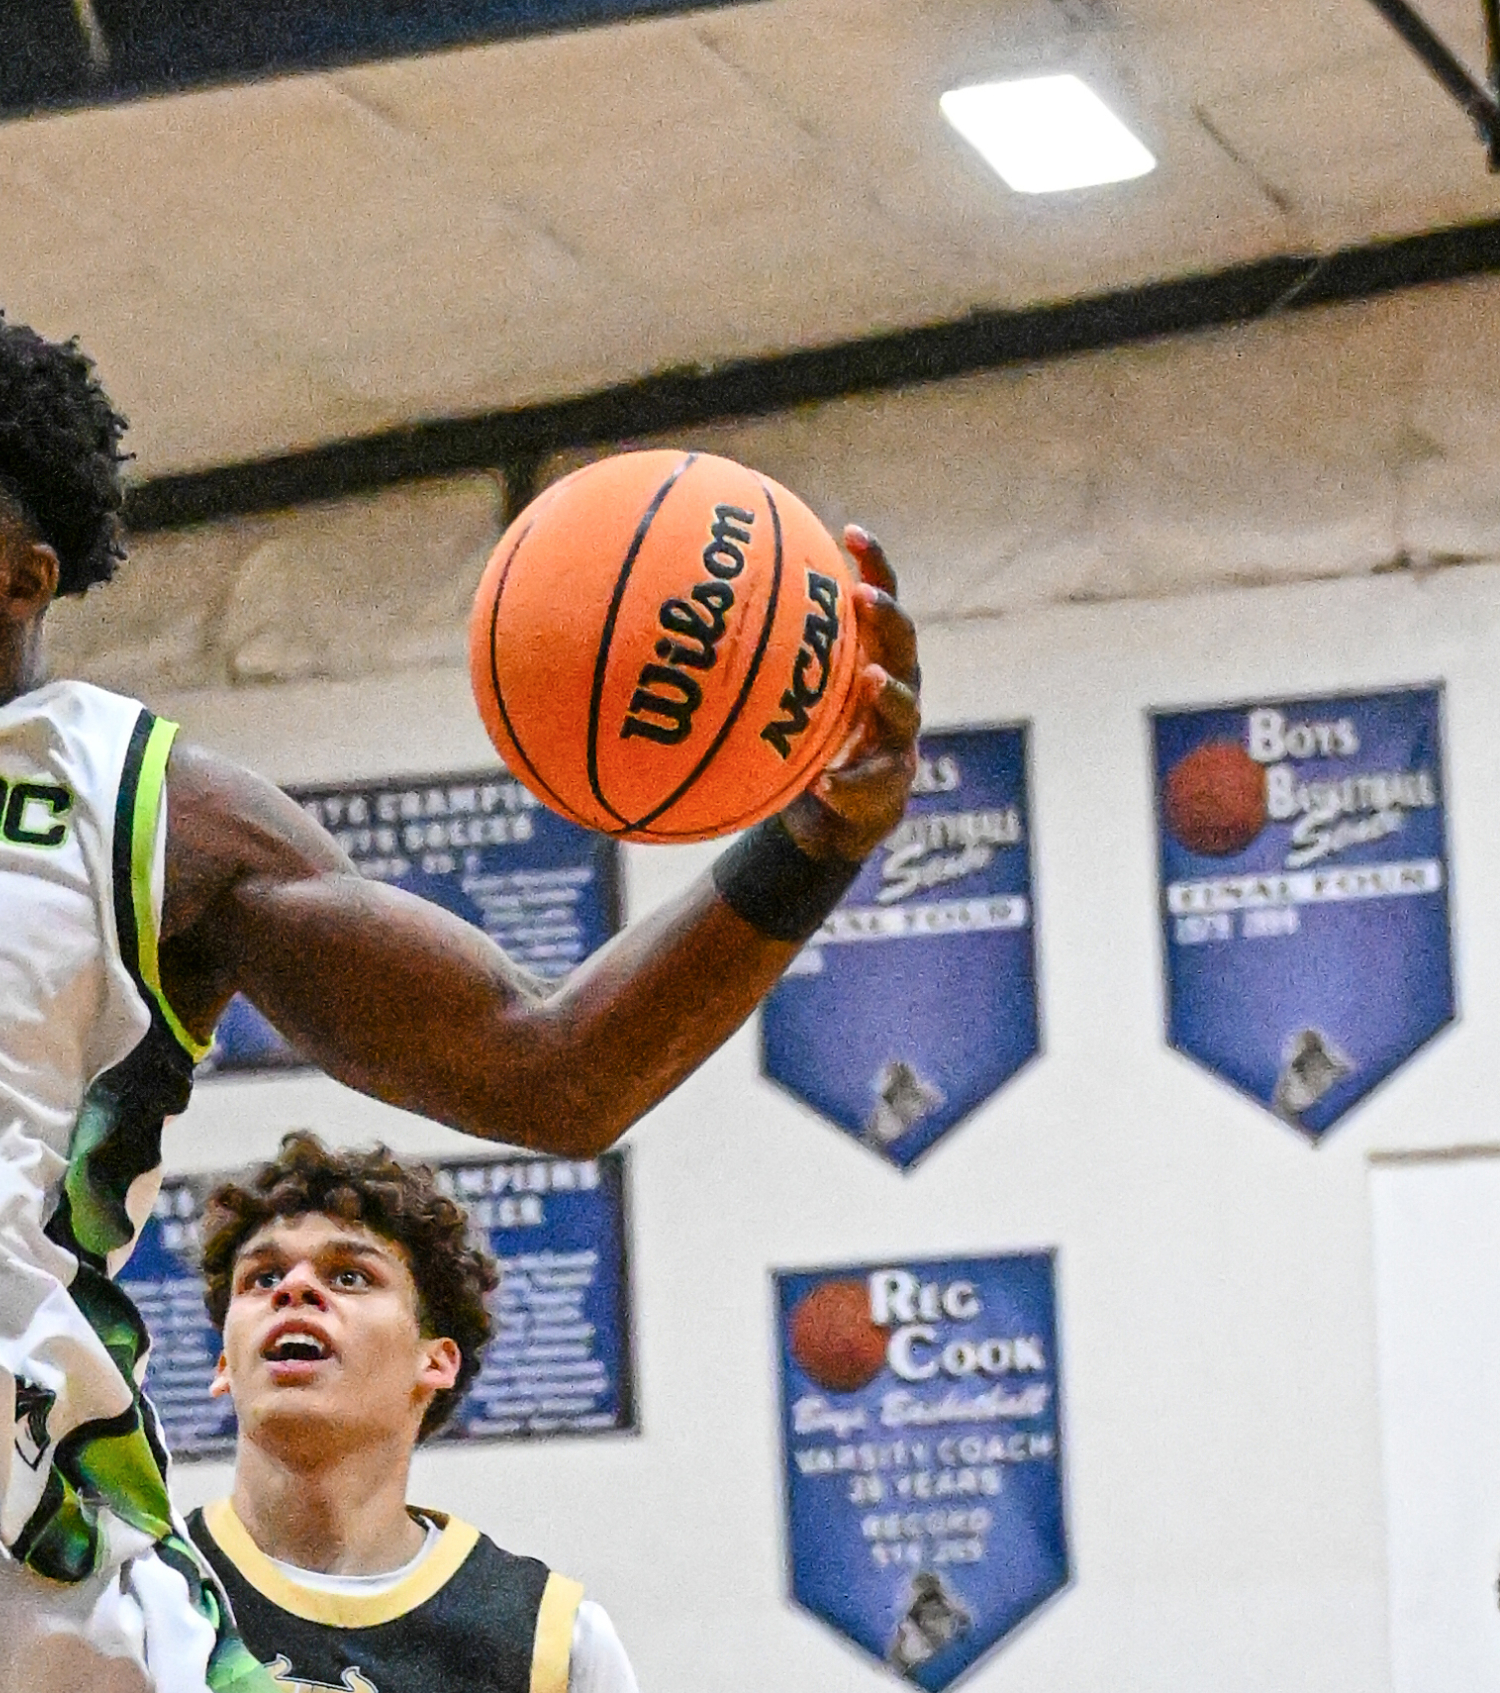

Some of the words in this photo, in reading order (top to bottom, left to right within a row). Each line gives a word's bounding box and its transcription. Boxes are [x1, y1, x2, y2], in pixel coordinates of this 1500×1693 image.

[620, 502, 756, 745] Wilson
[760, 571, 839, 760] NCAA
[937, 1433, 1055, 1466] COACH
